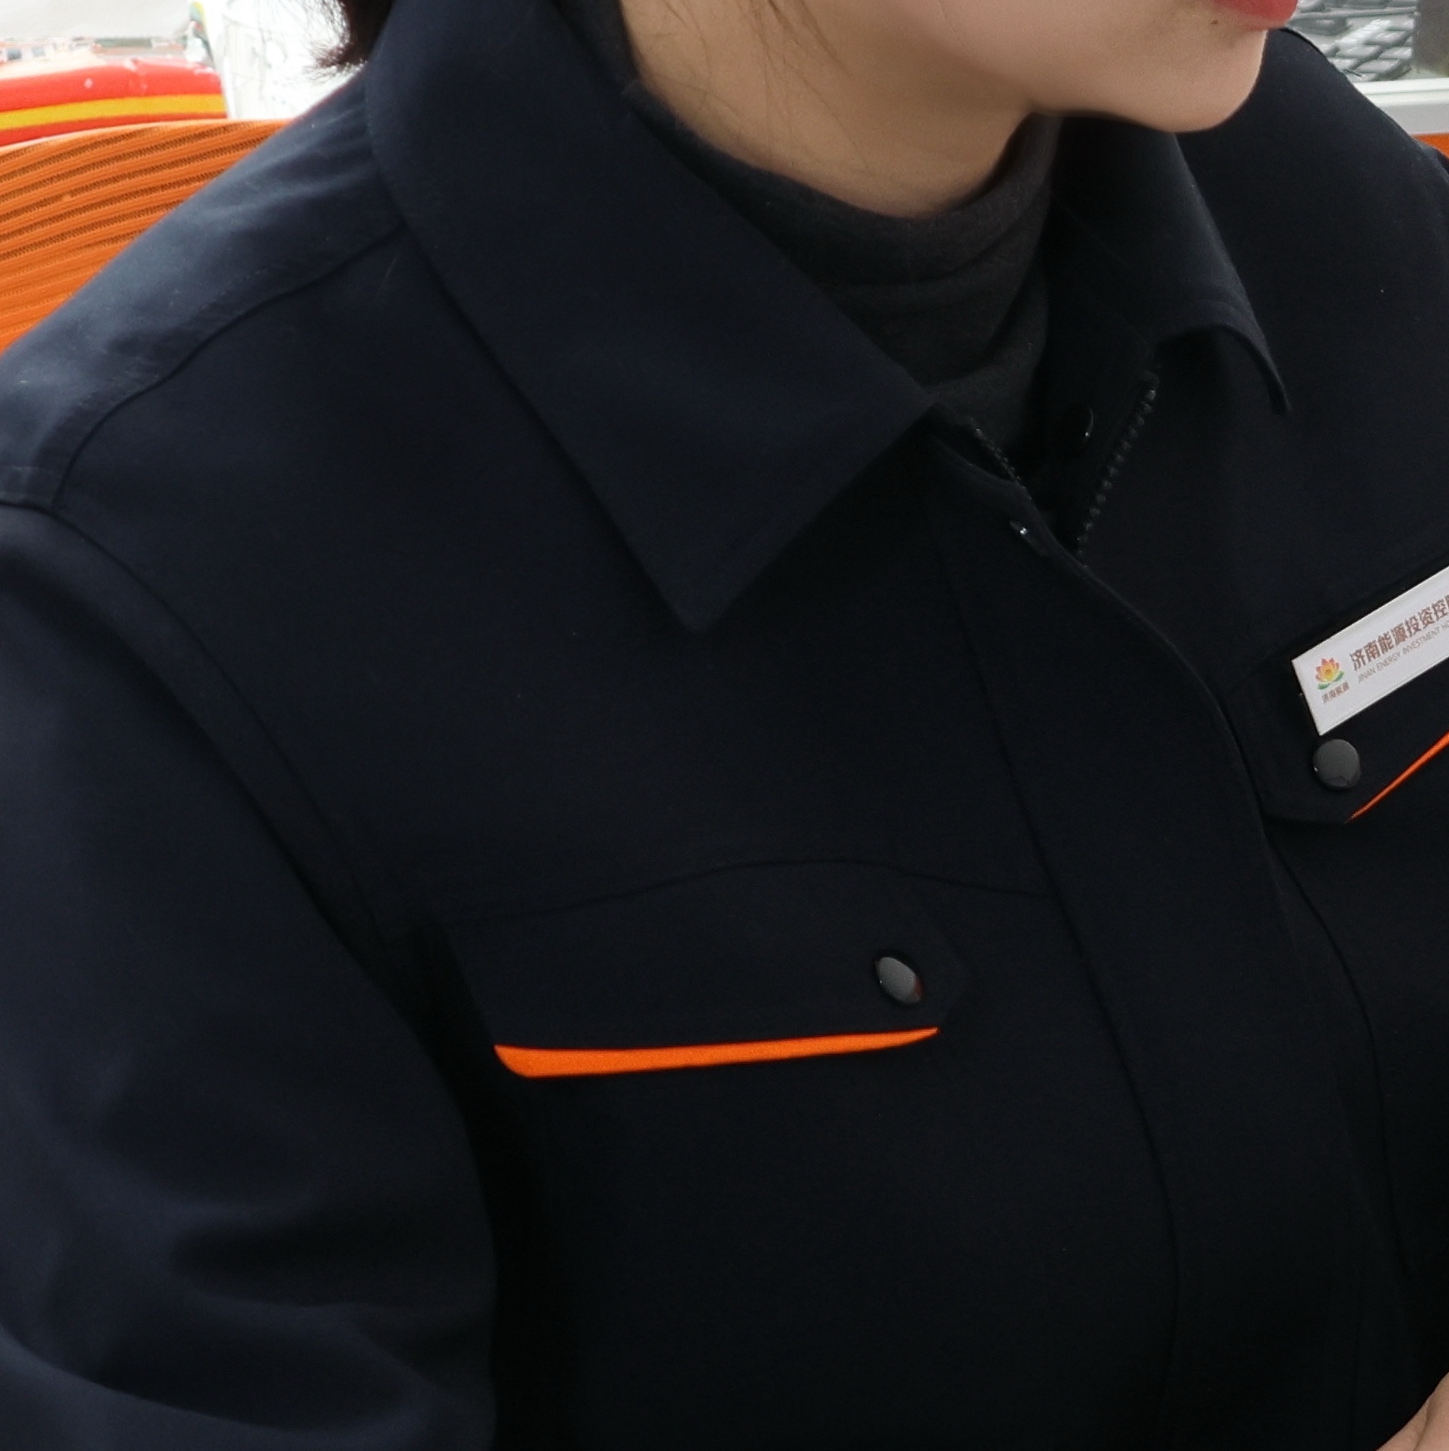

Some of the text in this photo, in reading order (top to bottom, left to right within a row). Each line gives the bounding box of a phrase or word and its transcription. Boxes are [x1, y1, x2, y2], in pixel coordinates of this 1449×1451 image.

[1358, 667, 1376, 684] JINAN
[1376, 653, 1402, 672] ENERGY
[1402, 625, 1440, 655] INVESTMENT
